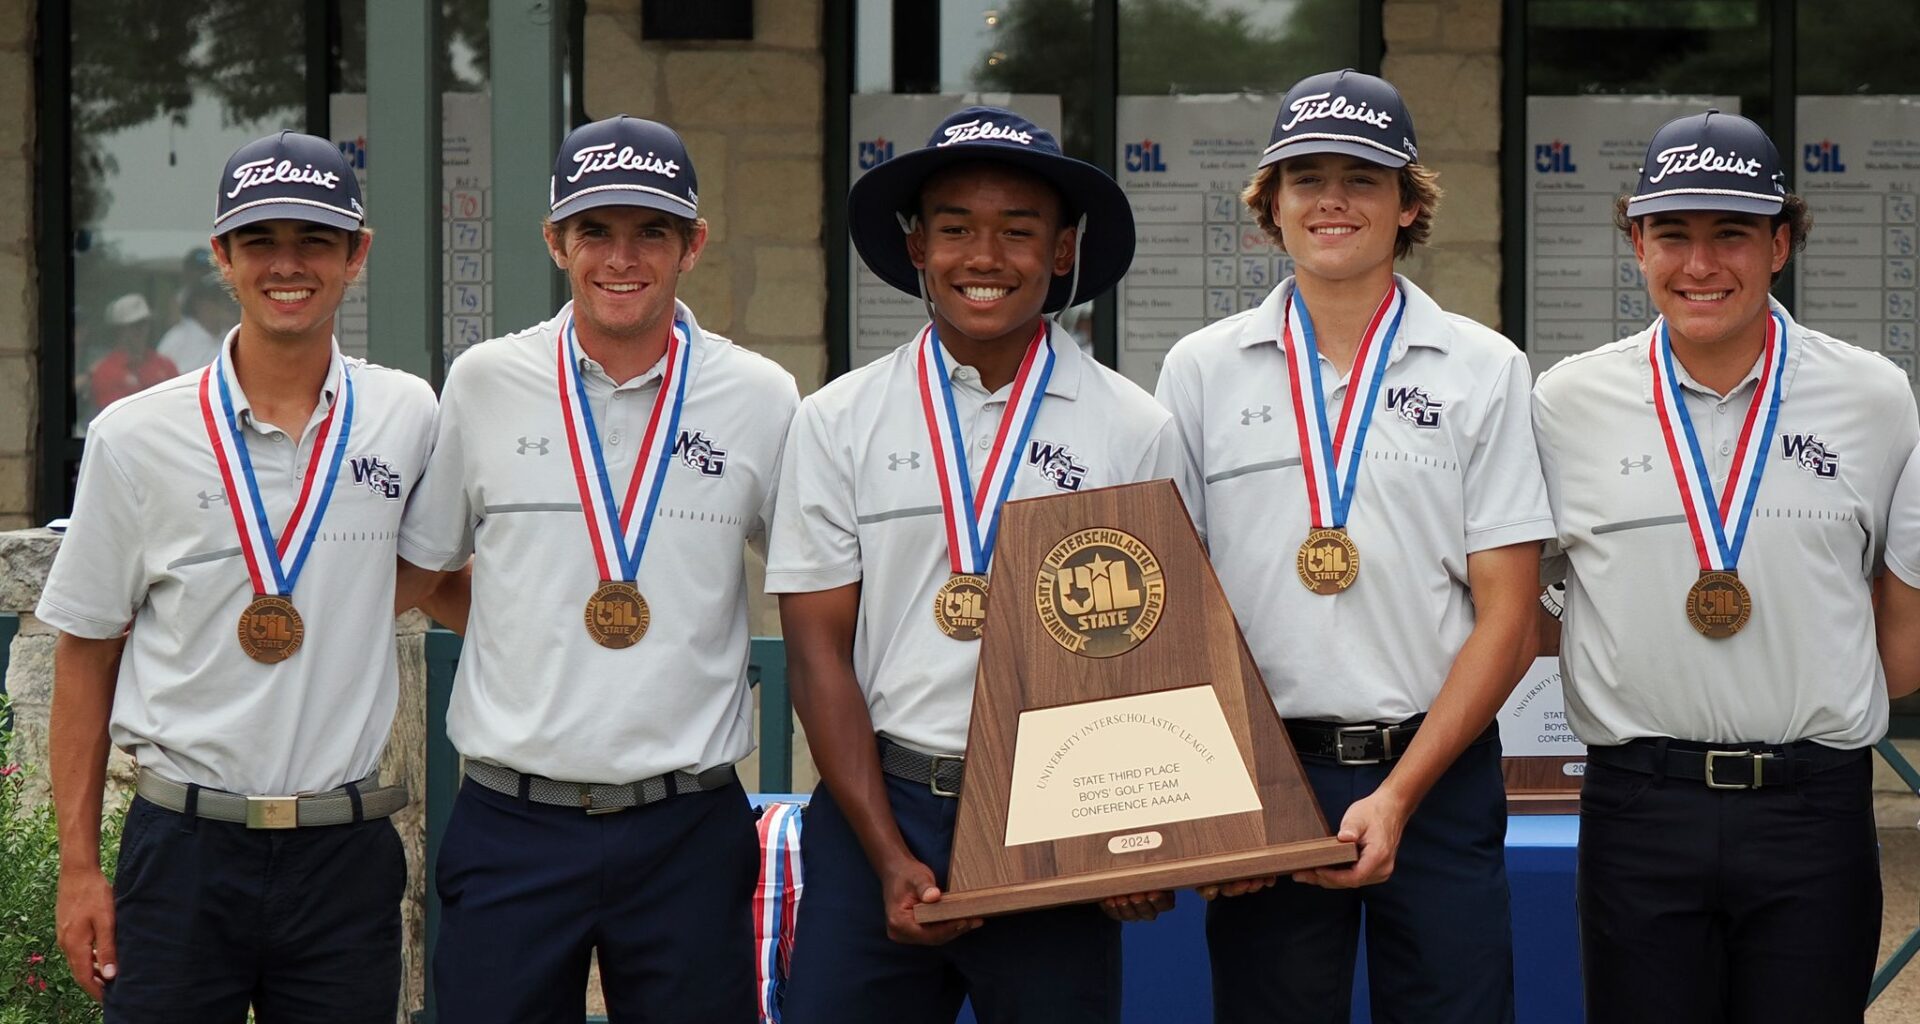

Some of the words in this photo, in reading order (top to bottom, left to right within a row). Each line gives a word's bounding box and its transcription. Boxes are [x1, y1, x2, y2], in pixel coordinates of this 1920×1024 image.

[1281, 92, 1392, 131] Titleist
[936, 119, 1033, 147] Titleist
[566, 142, 680, 183] Titleist
[1125, 139, 1167, 172] UIL
[1535, 139, 1577, 173] UIL
[1649, 143, 1762, 184] Titleist
[1804, 139, 1846, 173] UIL
[226, 157, 340, 199] Titleist
[456, 193, 478, 217] 70
[1049, 530, 1156, 572] INTERSCHOLASTIC
[1307, 543, 1347, 572] UIL
[944, 576, 988, 591] INTERSCHOLA
[1057, 552, 1141, 615] UIL
[1314, 572, 1340, 580] STATE
[596, 597, 637, 626] UIL
[945, 588, 986, 619] UIL
[1039, 576, 1078, 647] UNIVERSITY
[1135, 583, 1161, 636] LEAGUE
[1698, 585, 1739, 615] UIL
[250, 610, 292, 640] UIL
[604, 626, 630, 634] STATE
[951, 618, 977, 627] STATE
[1077, 610, 1128, 631] STATE
[1705, 615, 1733, 624] STATE
[256, 640, 284, 648] STATE
[1513, 677, 1553, 719] UNIVERSITY
[1036, 733, 1081, 790] UNIVERSITY
[1081, 713, 1180, 737] INTERSCHOLASTIC
[1178, 728, 1216, 764] LEAGUE
[1537, 734, 1580, 743] CONFERE
[1072, 774, 1106, 788] STATE
[1108, 768, 1142, 782] THIRD
[1144, 762, 1181, 776] PLACE
[1572, 764, 1585, 773] 20
[1078, 787, 1111, 802] BOYS'
[1115, 782, 1145, 797] GOLF
[1148, 778, 1179, 791] TEAM
[1071, 798, 1148, 819] CONFERENCE
[1151, 791, 1191, 807] AAAAA
[1121, 835, 1151, 849] 2024
